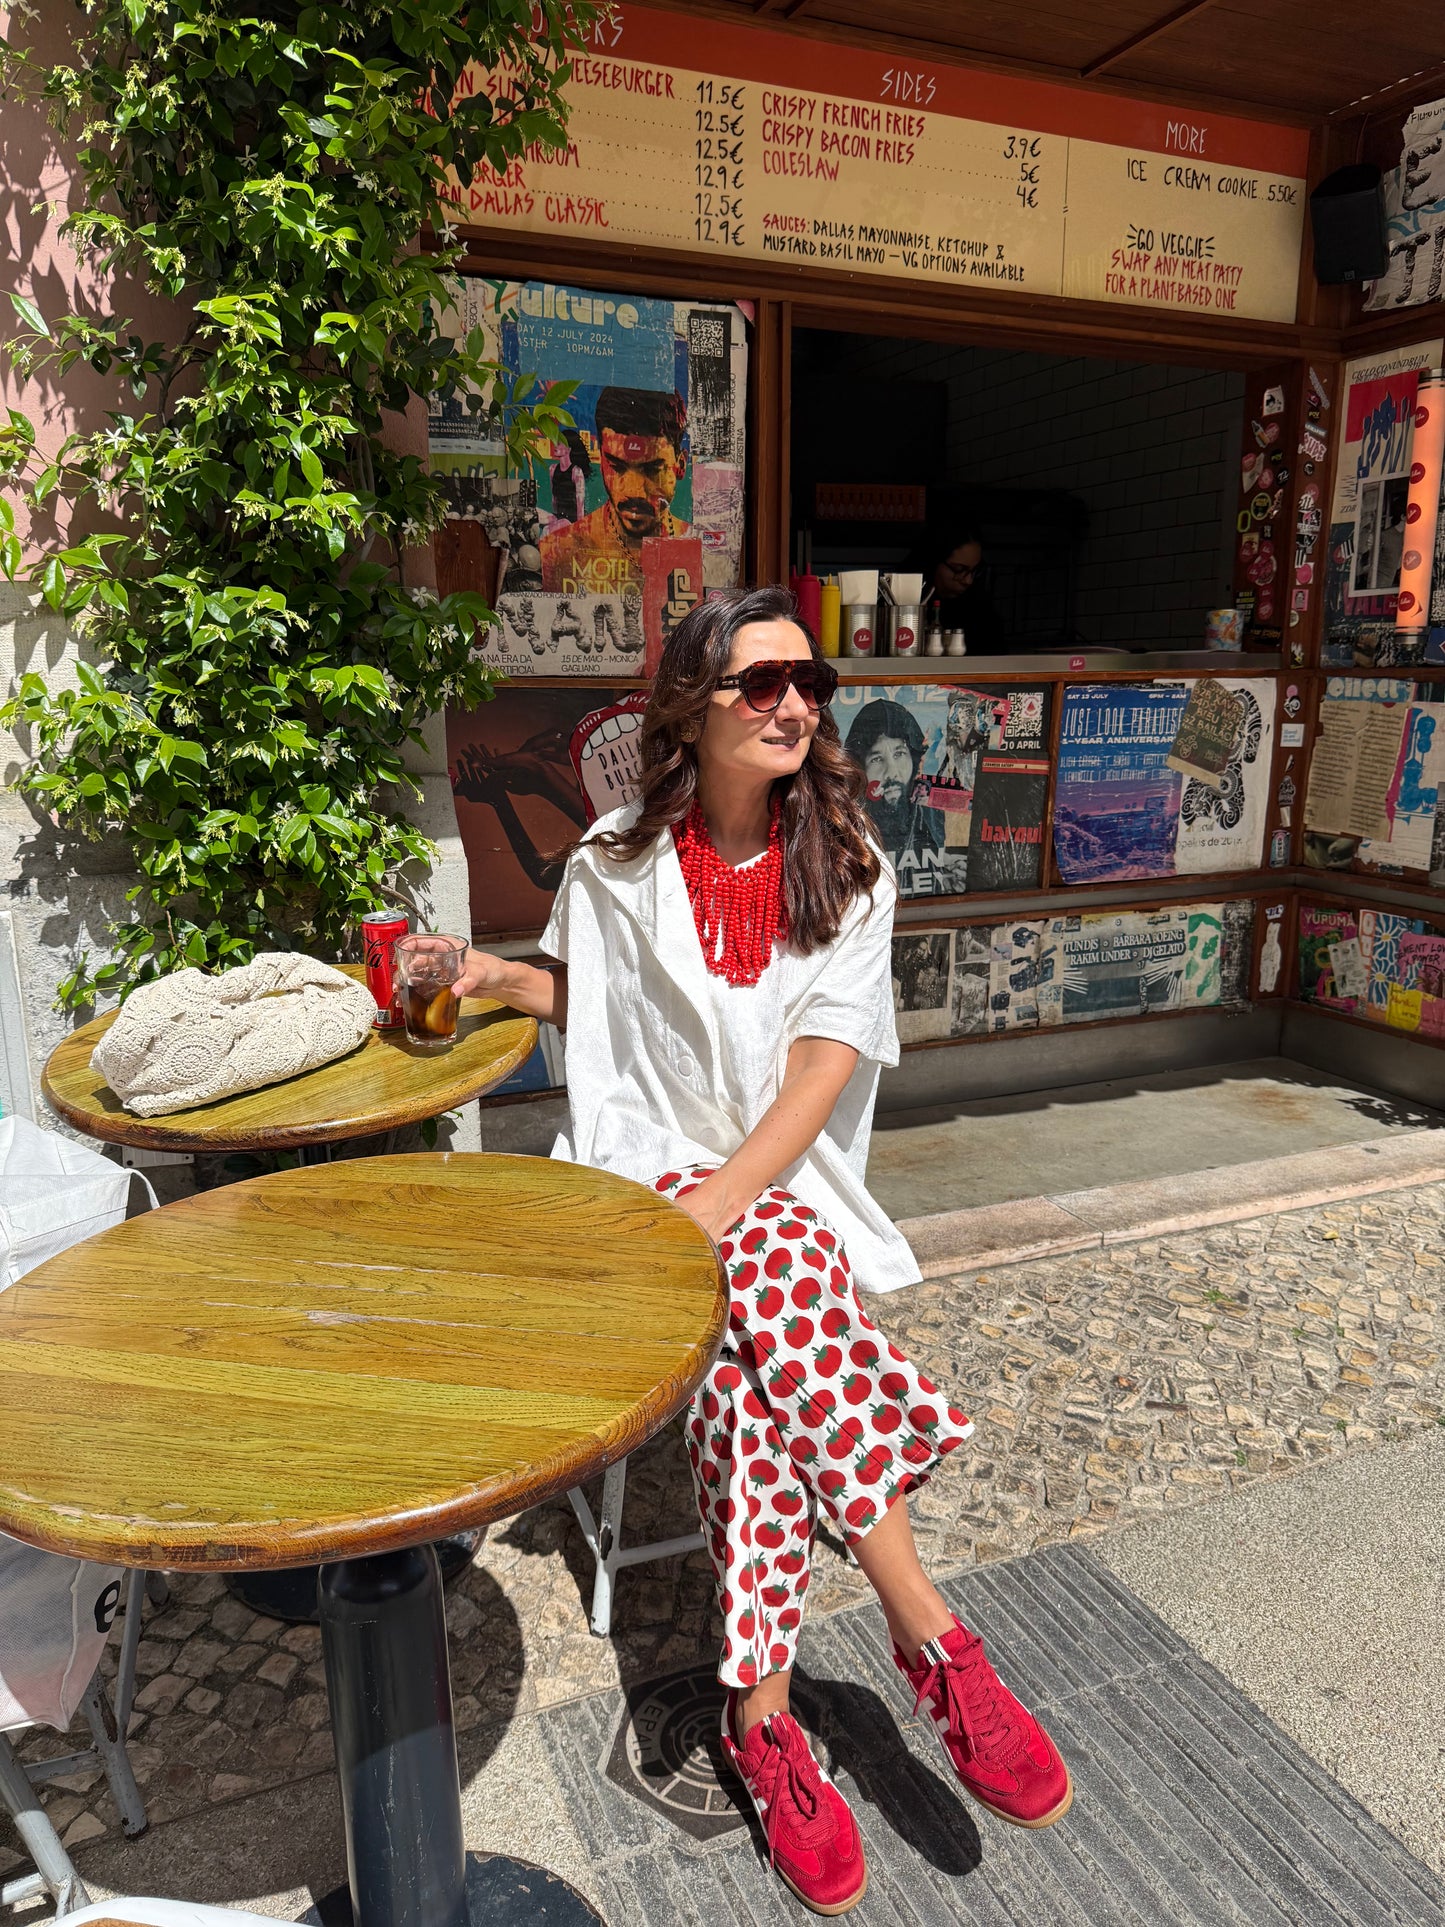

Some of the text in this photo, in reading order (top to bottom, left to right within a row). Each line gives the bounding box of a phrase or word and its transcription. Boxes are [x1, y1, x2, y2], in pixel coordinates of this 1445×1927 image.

[696, 79, 745, 110] 11.5€
[880, 68, 936, 104] SIDES
[695, 108, 745, 137] 12.5€
[762, 92, 1042, 159] CRISPY FRENCH FRIES 3.9€
[1165, 121, 1208, 154] MORE
[695, 138, 744, 165] 12.5€
[762, 119, 1040, 184] CRISPY BACON FRIES 5€
[695, 165, 744, 190] 12.9€
[763, 150, 1039, 209] COLESLAW 4€
[1127, 157, 1148, 182] ICE
[1164, 166, 1211, 192] CREAM
[469, 189, 534, 215] DALLAS
[545, 197, 609, 227] CLASSIC
[695, 218, 745, 248] 12.9€
[695, 192, 744, 219] 12.5€
[762, 213, 811, 234] SAUCES:
[938, 236, 988, 257] KETCHUP
[1137, 228, 1206, 259] GO VEGGIE
[820, 243, 853, 260] BASIL
[856, 246, 885, 264] MAYO
[902, 252, 919, 269] VG
[922, 255, 967, 275] OPTIONS
[970, 263, 1025, 282] AVAILABLE
[1111, 249, 1243, 287] SWAP ANY MEAT PATTY
[1105, 273, 1238, 310] FOR A PLANT-BASED ONE
[542, 327, 553, 337] 12
[559, 330, 584, 341] JULY
[590, 333, 614, 344] 2024
[566, 342, 615, 358] 10PM/6AM
[571, 556, 630, 580] MOTEL
[487, 654, 500, 664] NA
[502, 654, 519, 664] ERA
[520, 654, 533, 664] DA
[561, 655, 571, 663] 15
[572, 655, 582, 663] DE
[583, 655, 603, 664] MAIO
[609, 655, 639, 664] MONICA
[912, 685, 947, 703] 12
[1062, 708, 1091, 737] JUST
[1097, 707, 1125, 737] LOOK
[598, 738, 644, 771] DALLA
[1016, 740, 1041, 750] APRIL
[1070, 951, 1100, 966] RAKIM
[1101, 948, 1132, 962] UNDER
[632, 1704, 664, 1762] EPAL
